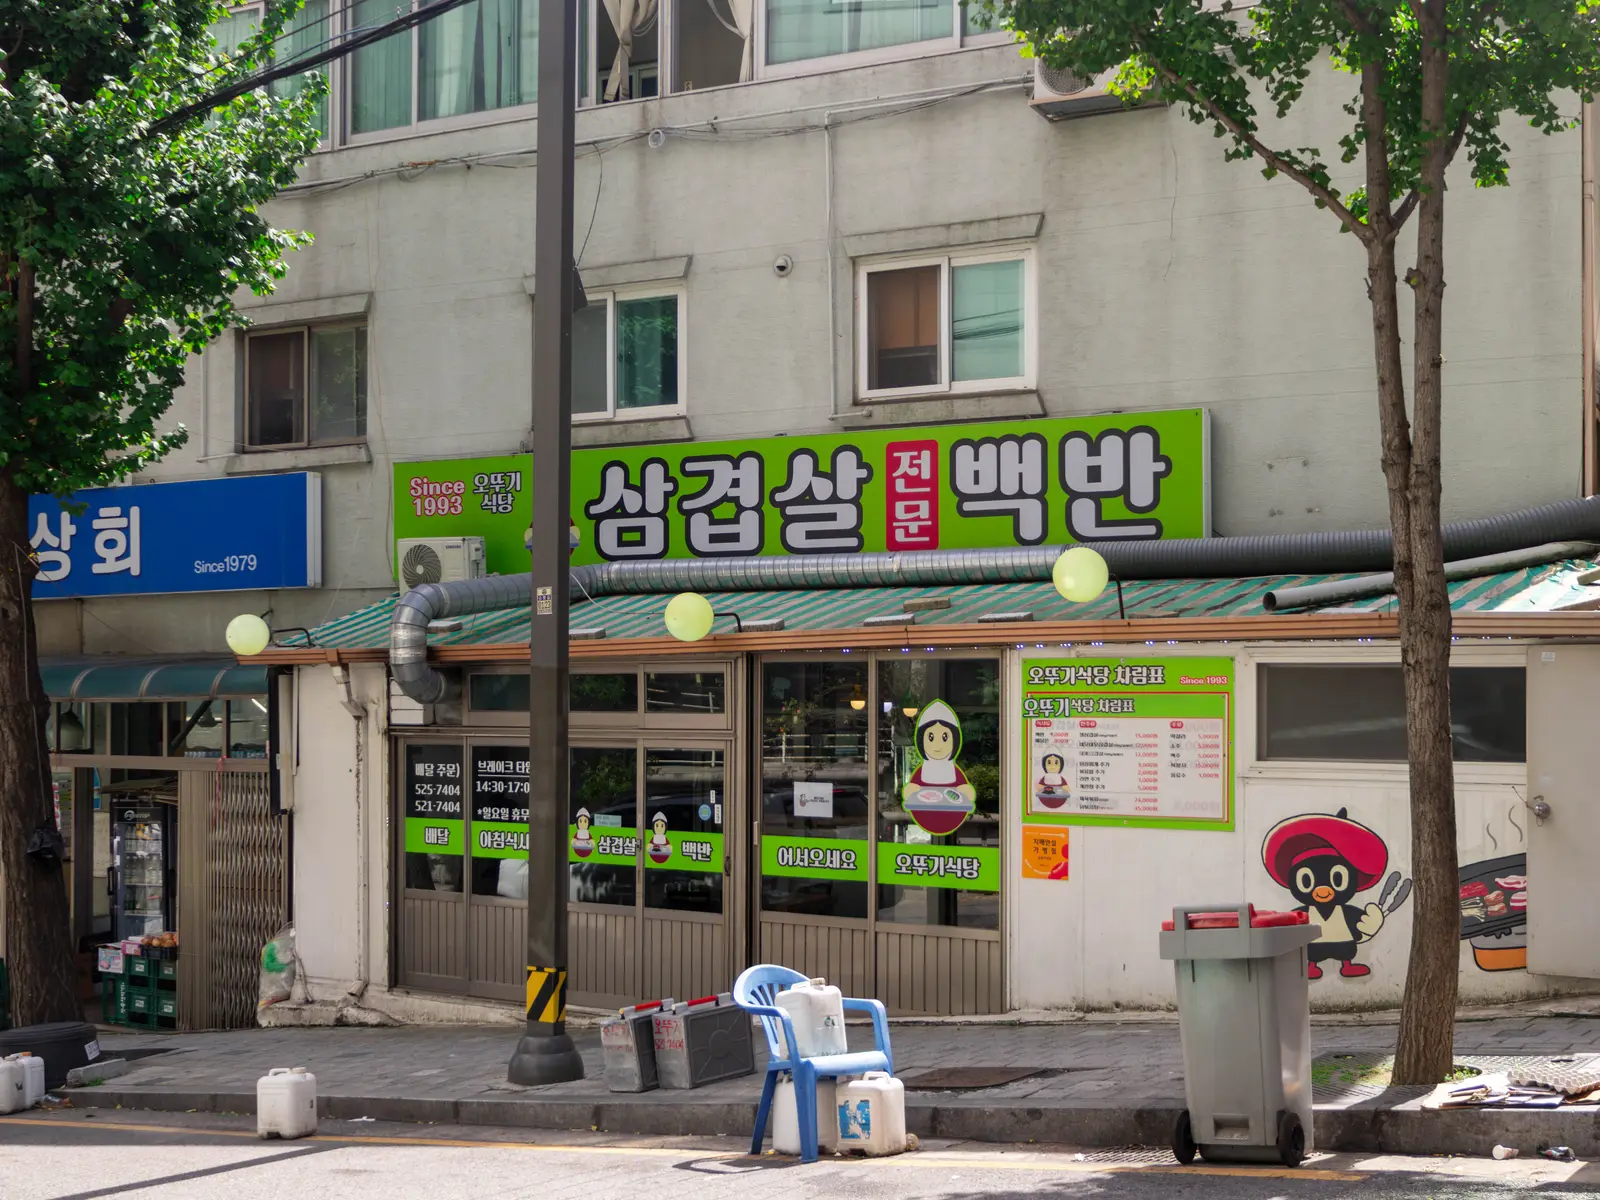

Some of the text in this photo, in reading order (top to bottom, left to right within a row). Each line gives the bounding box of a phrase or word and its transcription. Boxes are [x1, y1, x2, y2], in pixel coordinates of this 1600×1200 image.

[410, 477, 465, 496] Since
[473, 471, 522, 494] 오뚜기
[950, 424, 1173, 547] 백반
[413, 495, 463, 516] 1993
[480, 493, 514, 514] 식당
[584, 444, 874, 561] 삼겹살
[892, 450, 932, 542] 전문
[1028, 666, 1166, 686] 오뚜기식당 차림표
[1180, 676, 1228, 685] Since 1993
[1096, 698, 1136, 713] 차림표
[415, 763, 460, 778] 배달 주문)
[477, 761, 514, 774] 브레이크
[415, 784, 460, 796] 525-7404
[415, 800, 460, 813] 521-7404
[425, 826, 450, 845] 배달
[599, 836, 637, 855] 삼겹살
[682, 841, 713, 861] 백반
[777, 846, 857, 870] 어서오세요
[895, 853, 980, 879] 오뚜기식당
